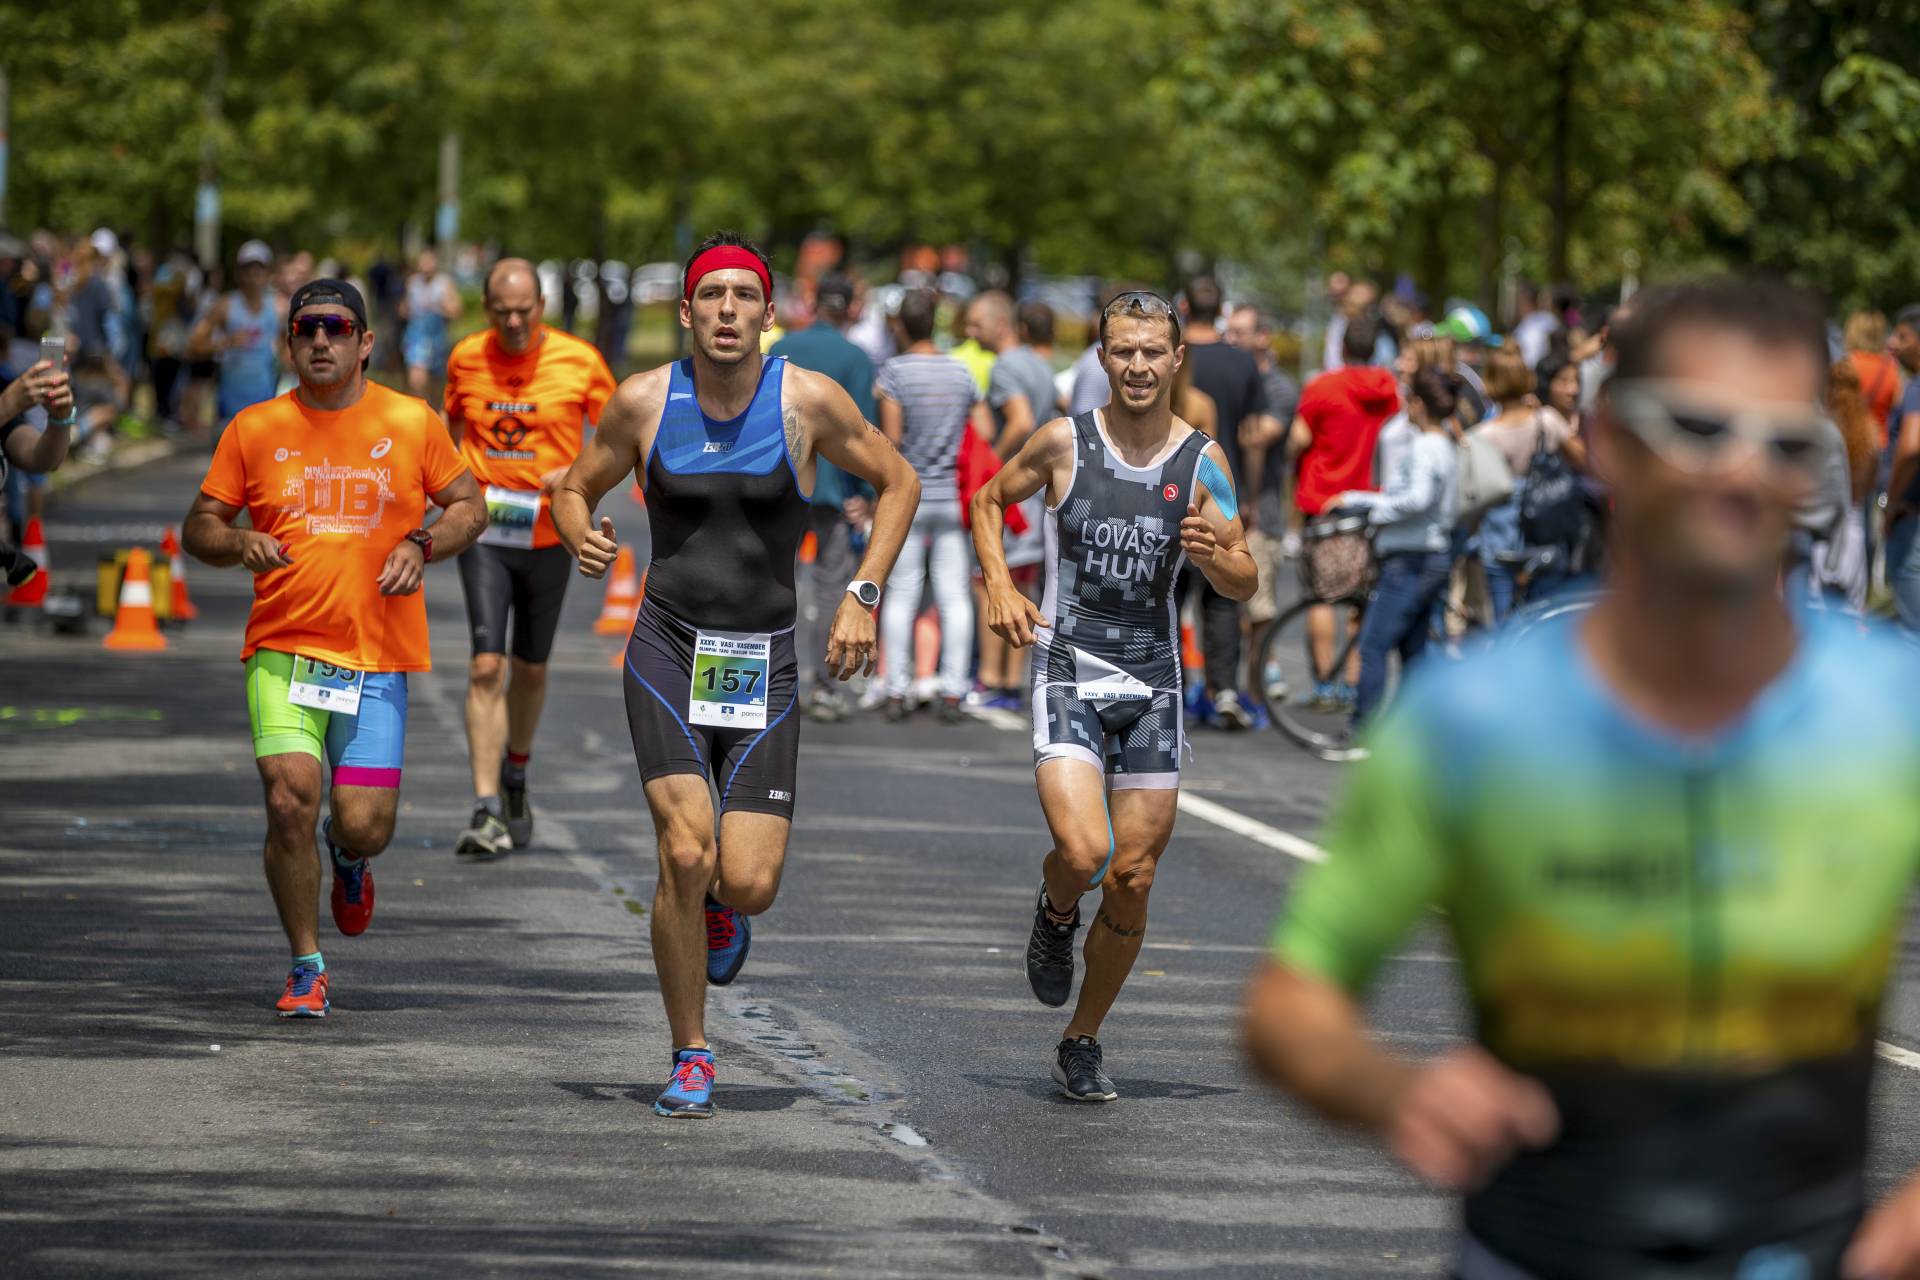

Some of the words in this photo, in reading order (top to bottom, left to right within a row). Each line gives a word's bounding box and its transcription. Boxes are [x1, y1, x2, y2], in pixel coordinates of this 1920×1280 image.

[1081, 521, 1171, 556] LOVÁSZ
[1084, 550, 1157, 582] HUN
[700, 639, 717, 647] XXXV.
[736, 642, 766, 651] VASEMBER
[702, 666, 762, 694] 157
